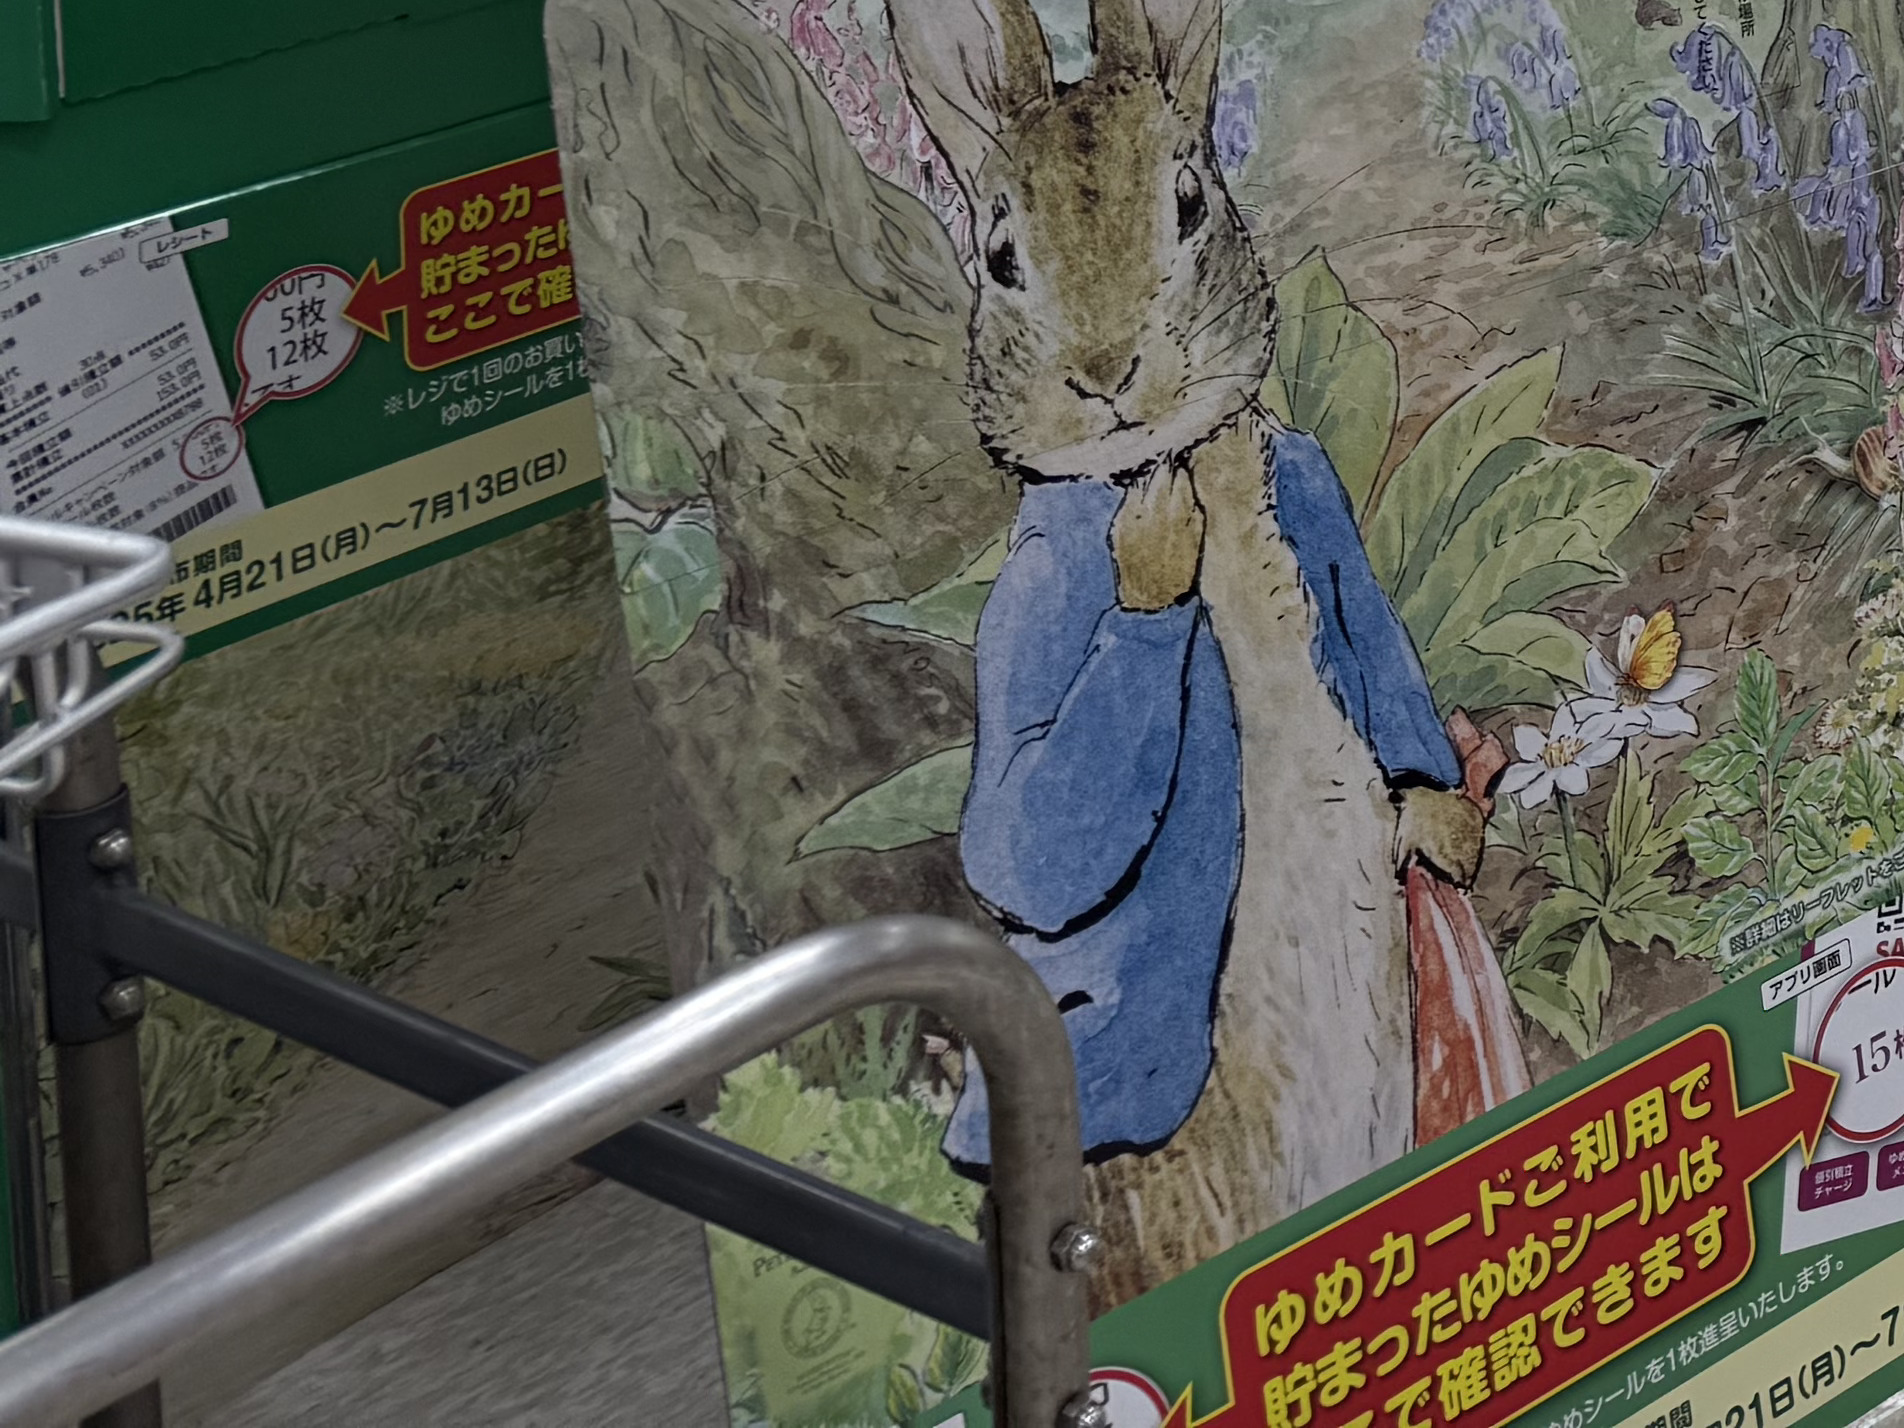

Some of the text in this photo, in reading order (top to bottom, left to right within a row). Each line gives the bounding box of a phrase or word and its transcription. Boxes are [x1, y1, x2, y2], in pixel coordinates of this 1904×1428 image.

[155, 227, 213, 254] レシート
[279, 295, 328, 335] 5枚
[264, 328, 329, 373] 12枚
[1768, 948, 1844, 1002] アプリ画面
[1254, 1061, 1713, 1358] ゆめカードご利用で
[1813, 1176, 1854, 1200] チャージ
[1261, 1135, 1725, 1428] 貯まったゆめシールは
